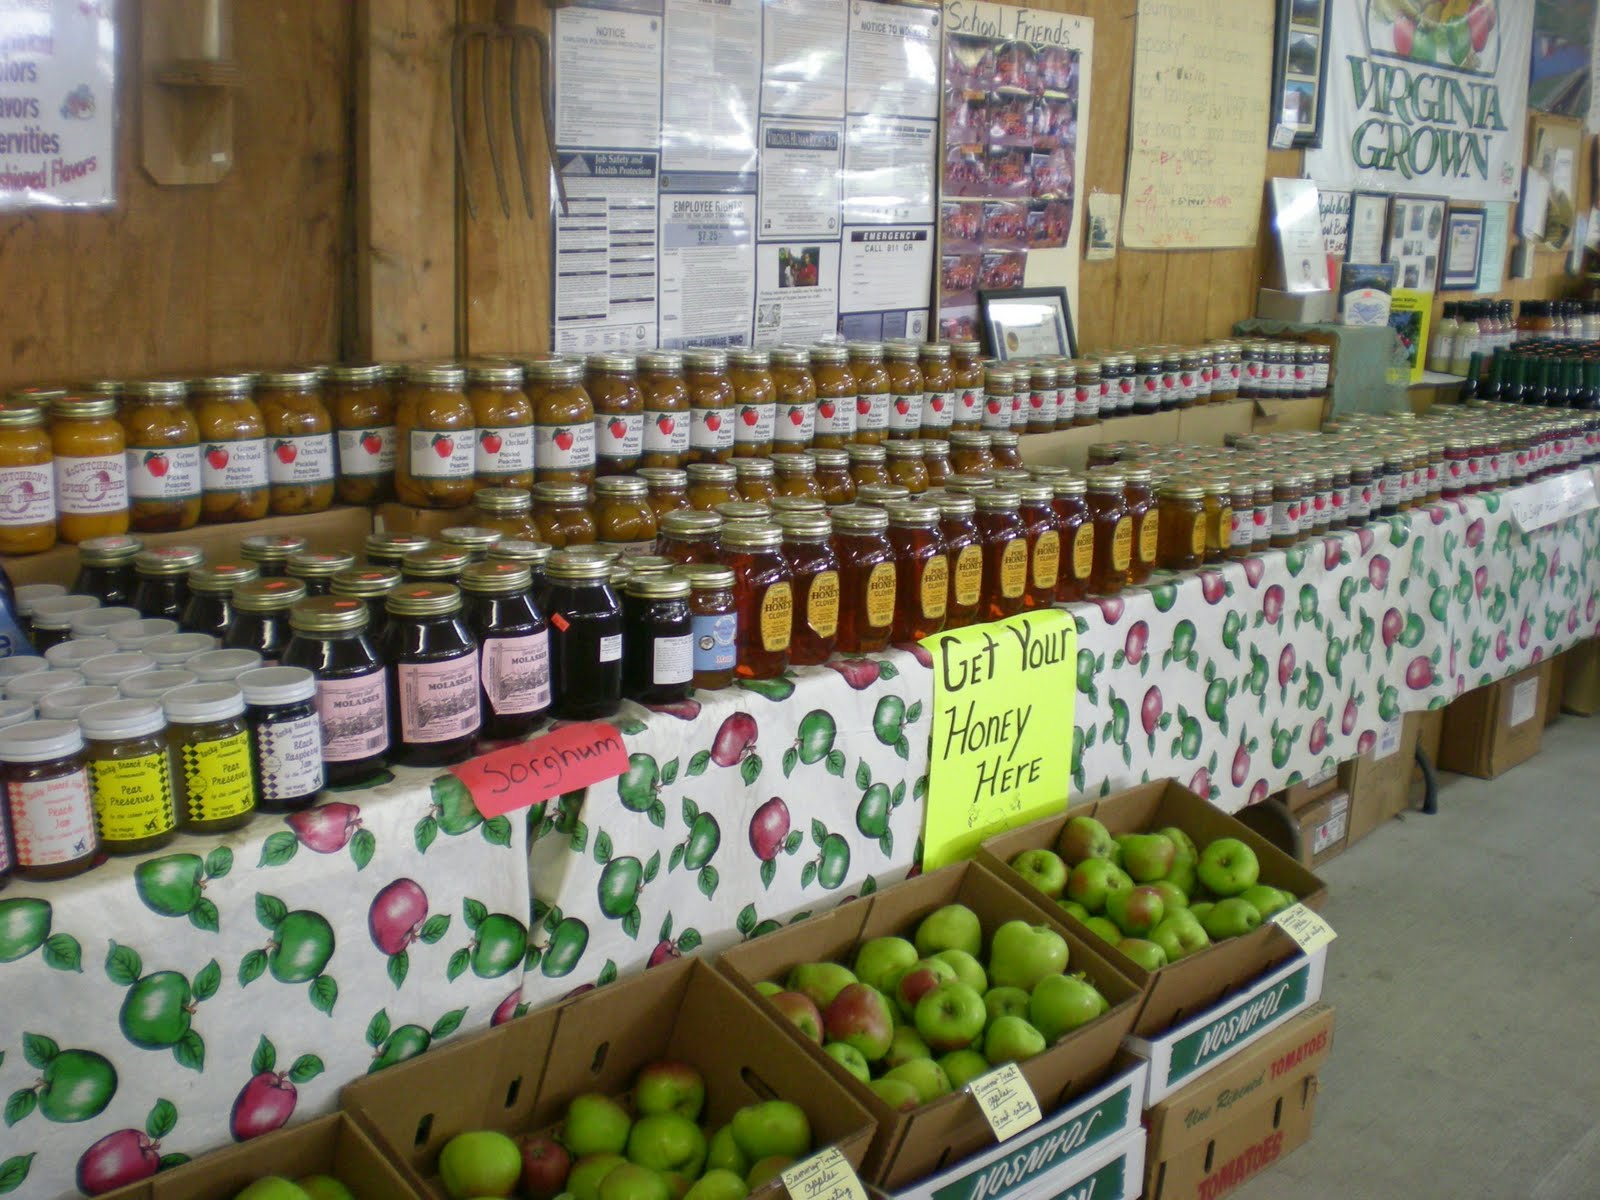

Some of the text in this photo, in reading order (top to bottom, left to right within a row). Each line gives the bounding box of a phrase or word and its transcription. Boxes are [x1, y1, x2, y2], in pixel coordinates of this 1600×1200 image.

[597, 26, 626, 38] NOTICE
[861, 21, 886, 33] NOTICE
[888, 24, 897, 34] TO
[1345, 54, 1508, 132] VIRGINIA
[1351, 118, 1493, 180] GROWN
[608, 154, 629, 166] Safety
[595, 164, 651, 175] Health Protection
[673, 201, 712, 212] EMPLOYEE
[863, 232, 917, 241] EMERGENCY
[865, 244, 882, 252] CALL
[1007, 619, 1073, 671] Your
[428, 675, 473, 690] MOLASSES
[333, 693, 380, 708] MOLASSES
[223, 763, 240, 773] Pear
[484, 738, 620, 794] Sorghum
[121, 785, 142, 795] Pear
[110, 794, 155, 806] Preserves
[1194, 983, 1289, 1066] JOHNSON
[1270, 1029, 1329, 1080] TOMATOES
[970, 1110, 1102, 1200] JOHNSON
[1198, 1130, 1284, 1200] TOMATOES
